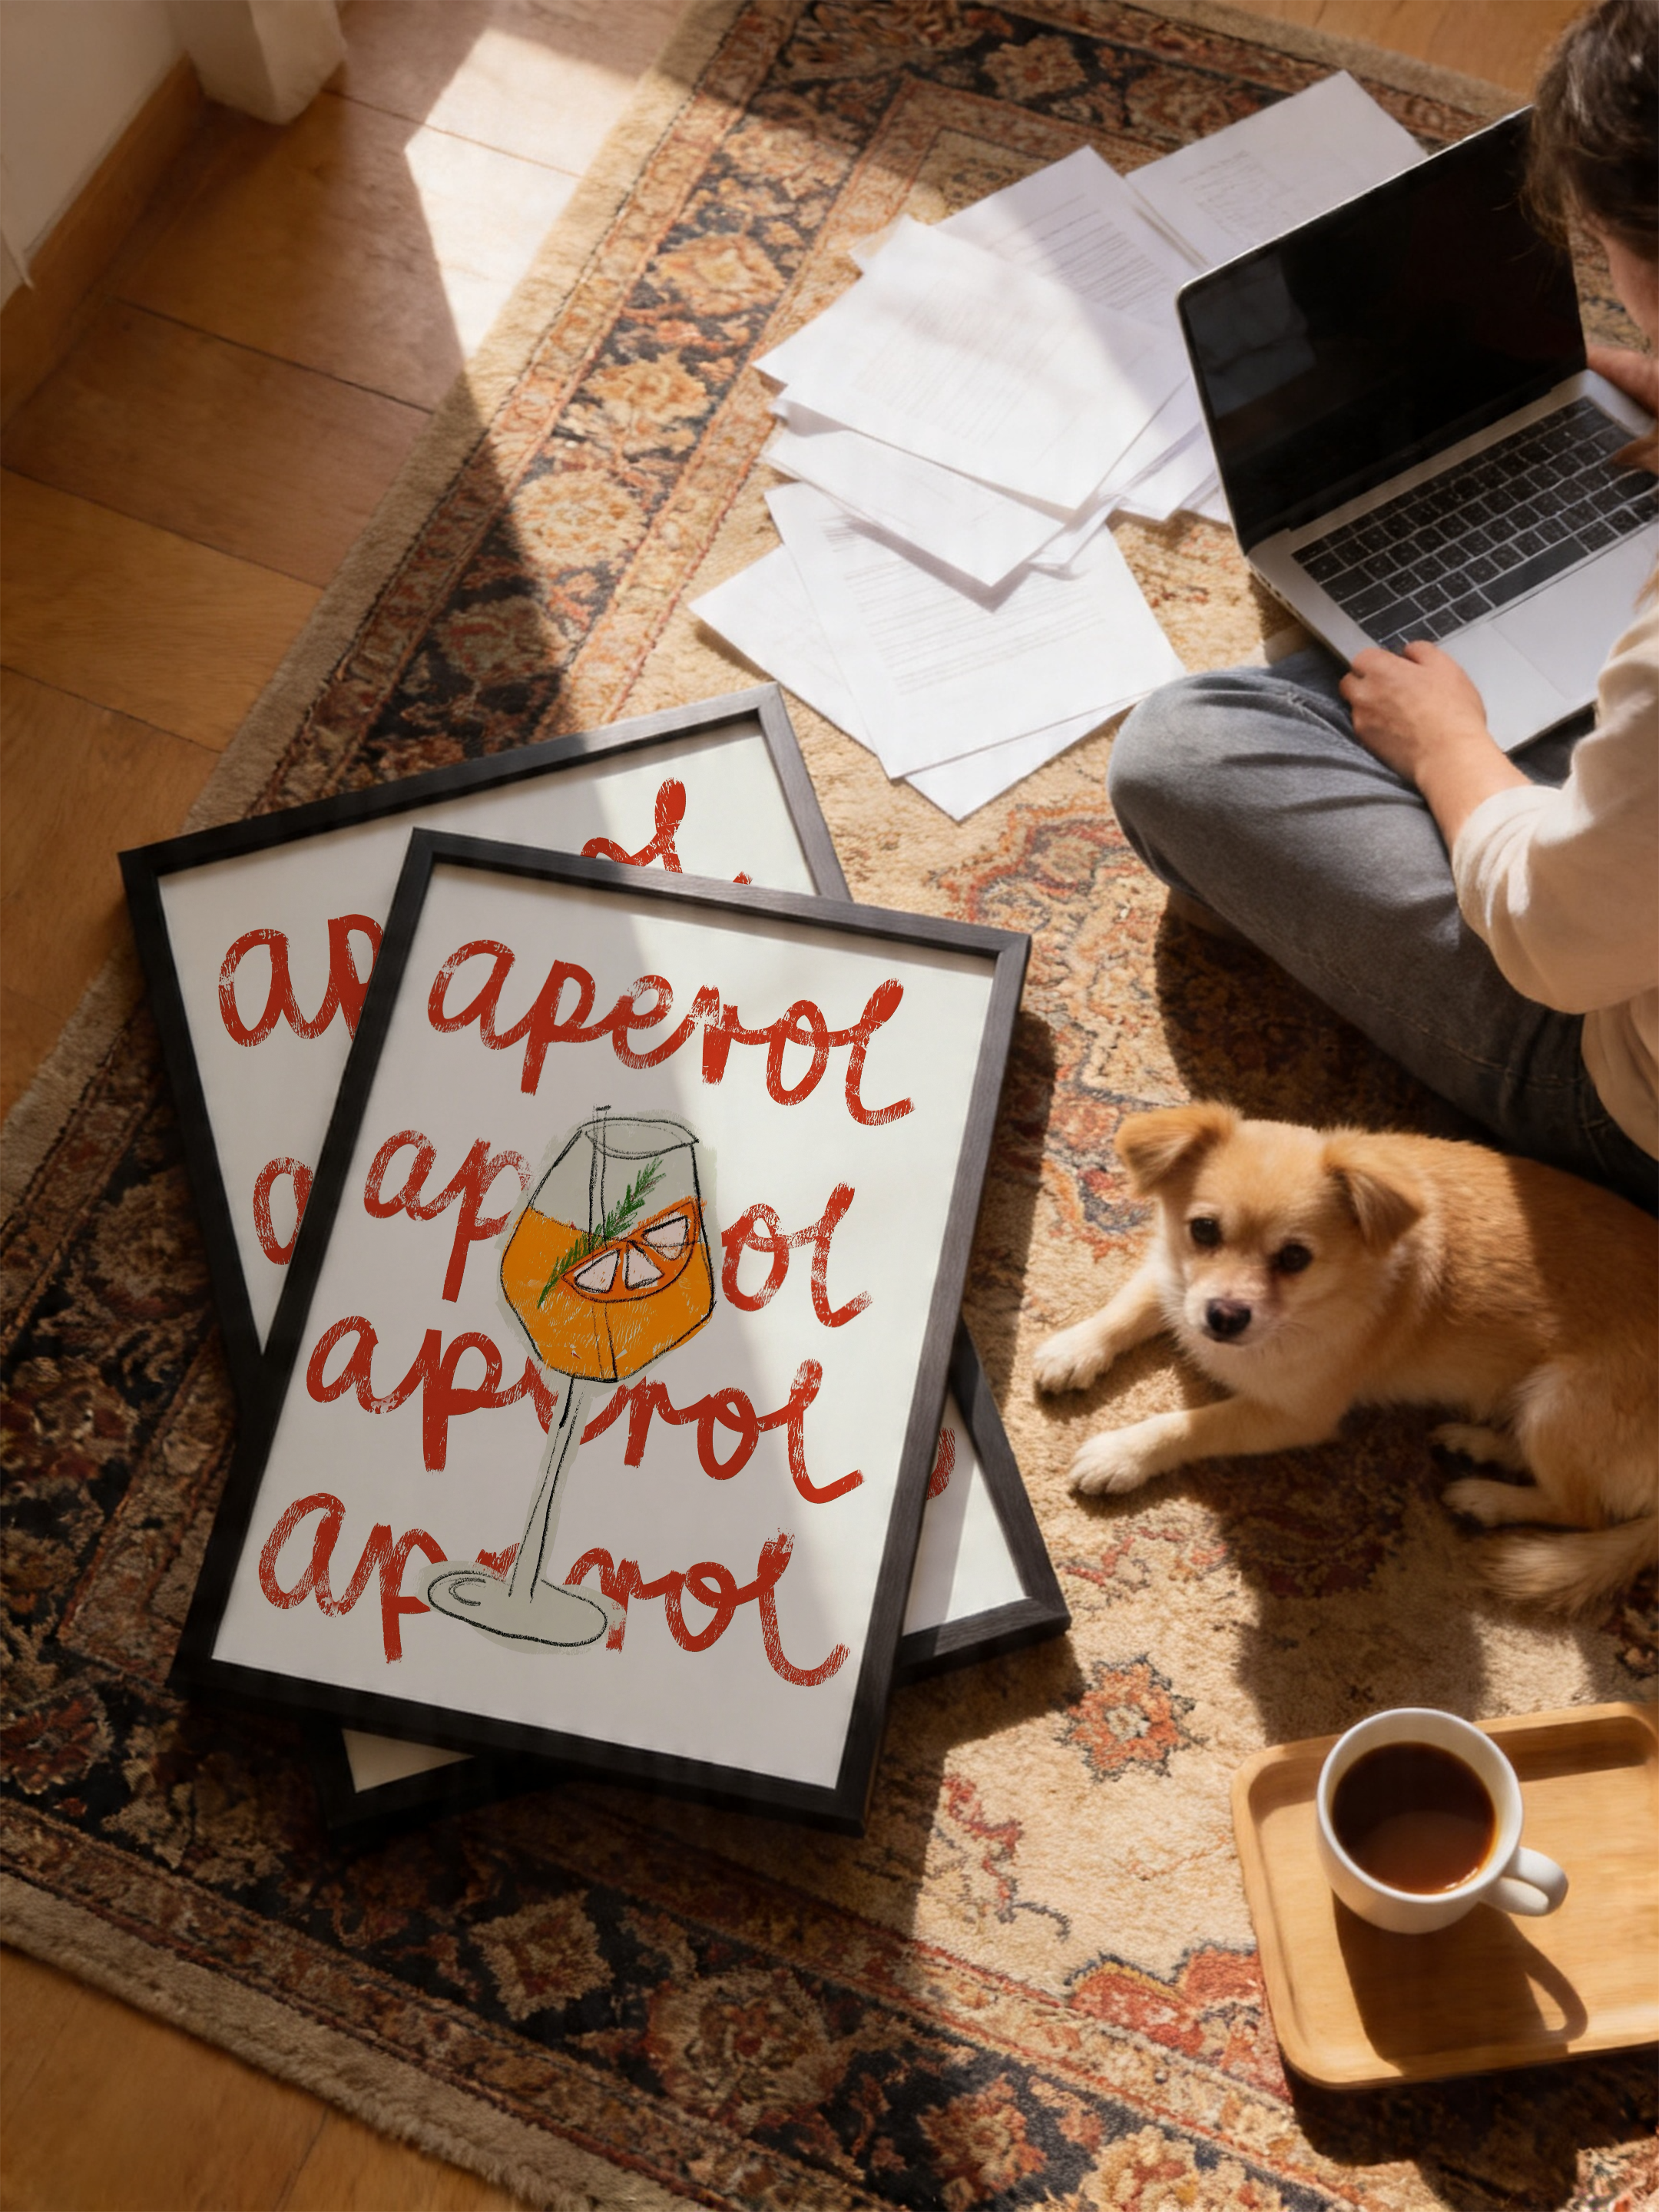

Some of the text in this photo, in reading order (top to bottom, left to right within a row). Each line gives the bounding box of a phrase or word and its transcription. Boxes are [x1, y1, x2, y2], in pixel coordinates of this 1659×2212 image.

[427, 939, 914, 1126] aperol
[363, 1129, 873, 1328] apol
[258, 1492, 850, 1687] aprol
